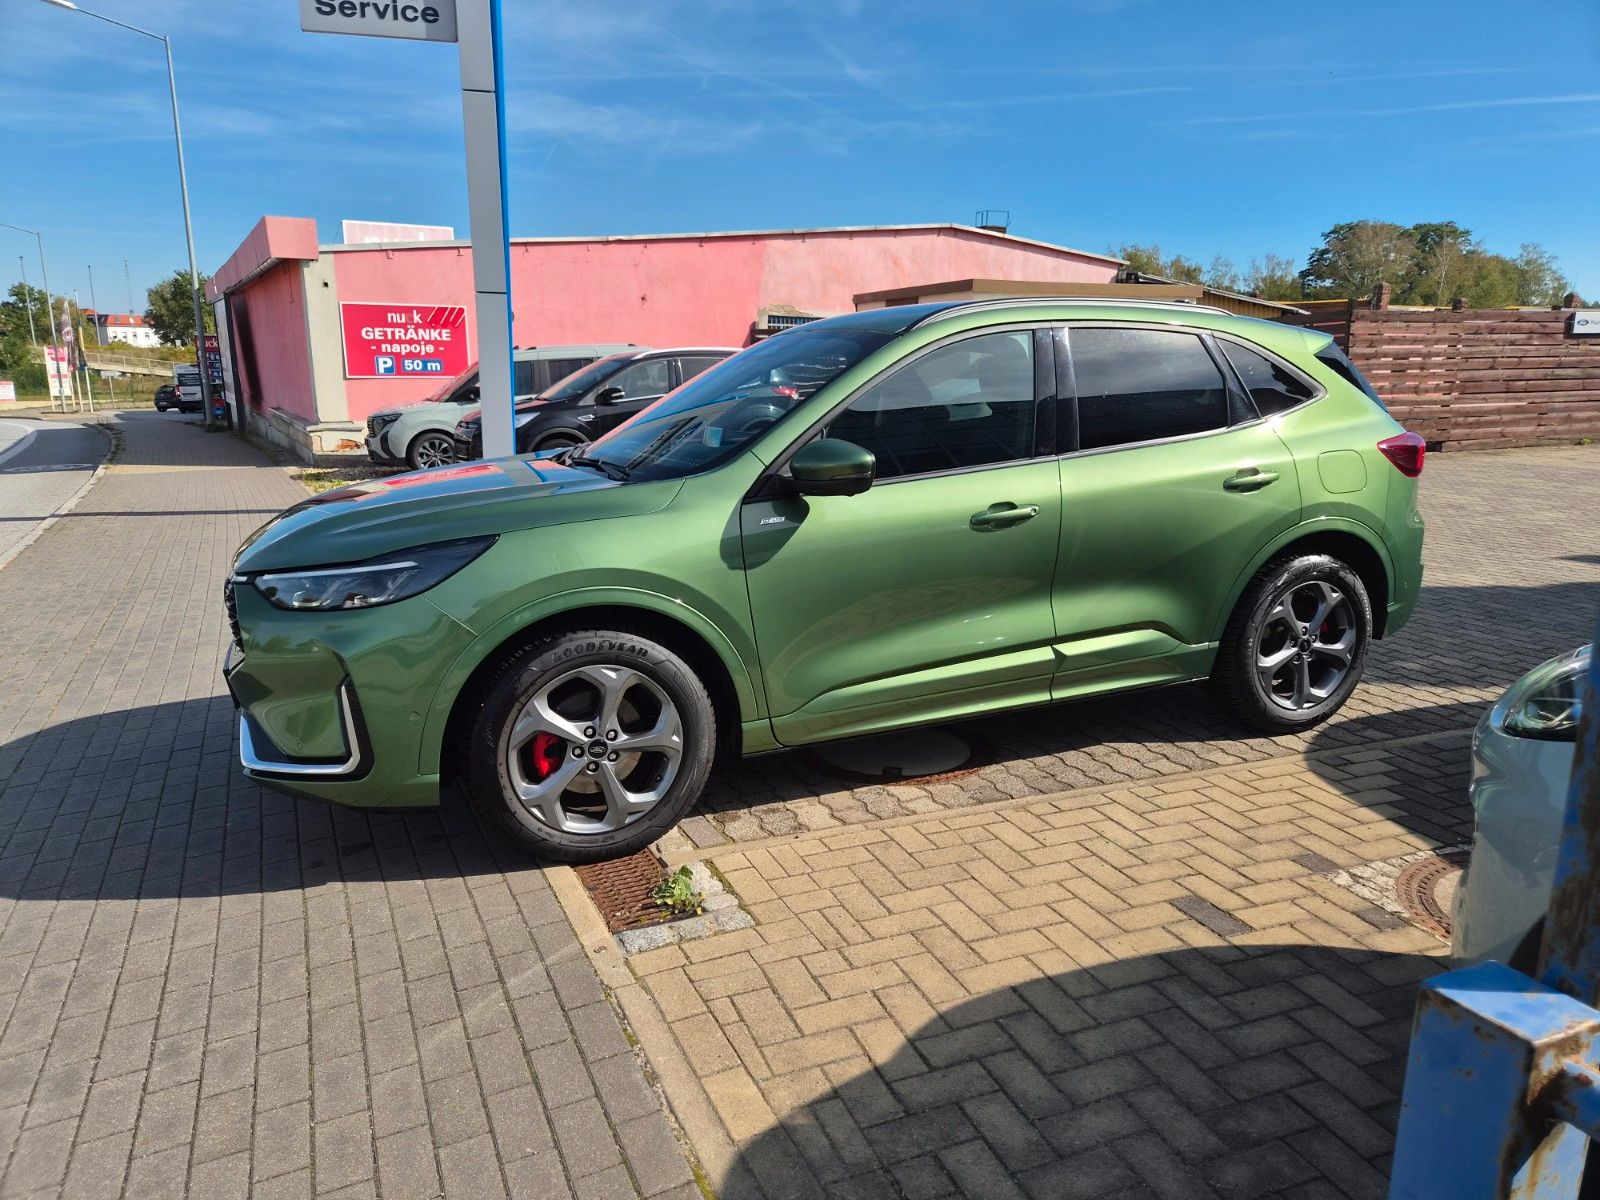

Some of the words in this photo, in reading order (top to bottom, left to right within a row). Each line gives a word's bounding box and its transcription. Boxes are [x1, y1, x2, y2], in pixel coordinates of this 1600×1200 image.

[315, 0, 440, 23] Service
[361, 325, 451, 341] GETRÄNKE
[381, 341, 435, 355] napoje
[377, 357, 393, 374] P
[404, 360, 423, 371] 50
[427, 362, 440, 371] m
